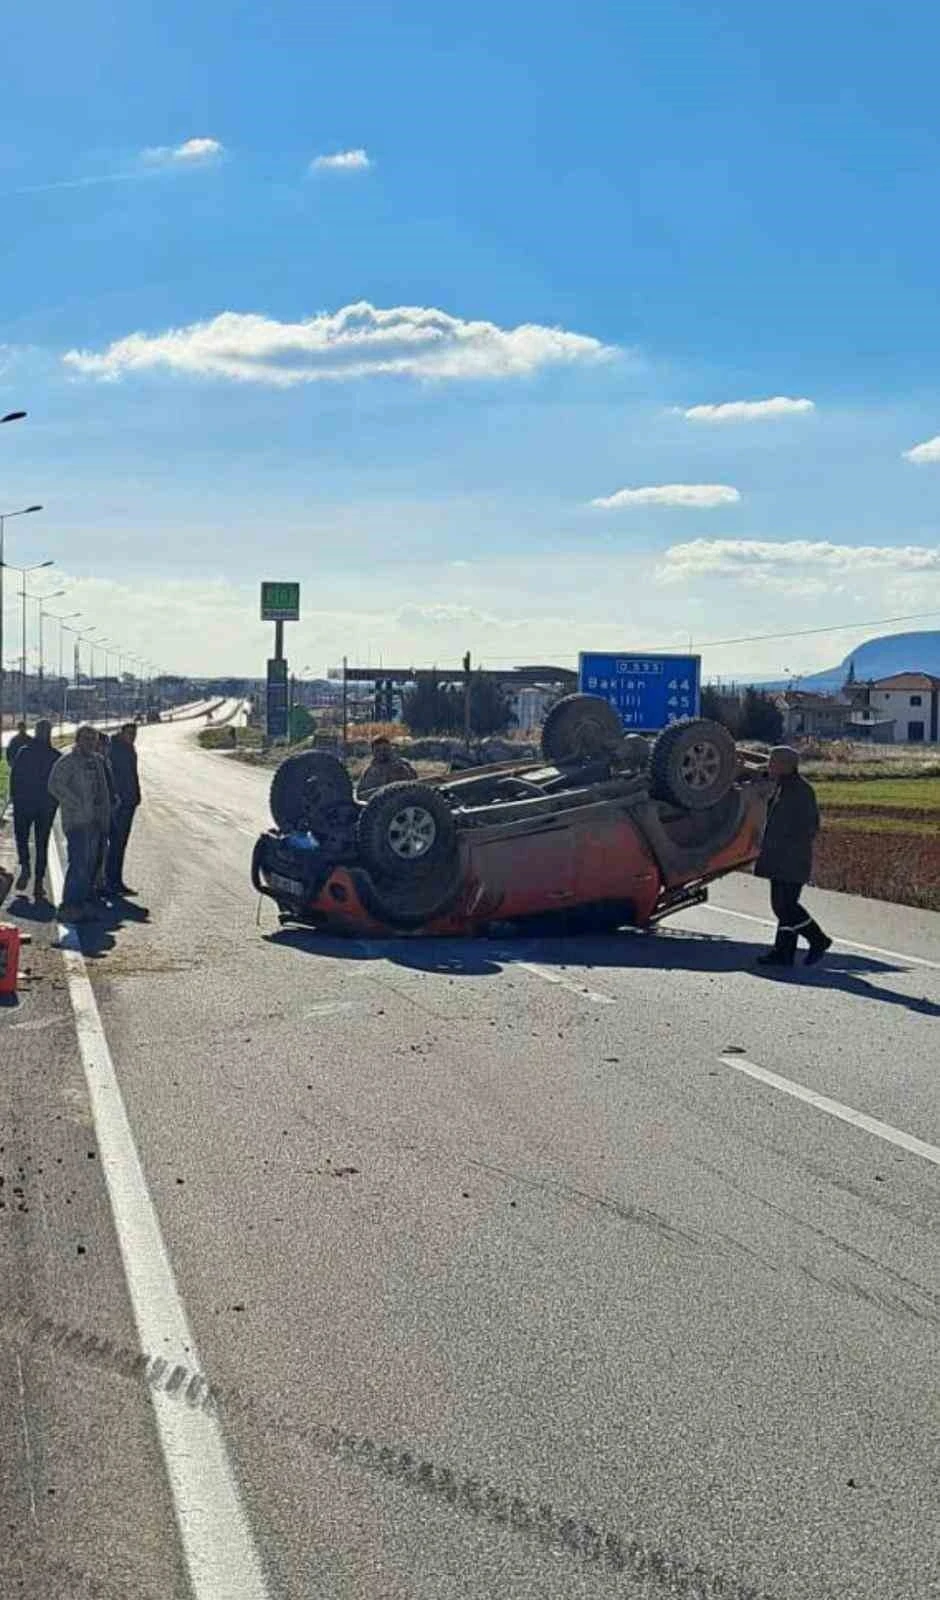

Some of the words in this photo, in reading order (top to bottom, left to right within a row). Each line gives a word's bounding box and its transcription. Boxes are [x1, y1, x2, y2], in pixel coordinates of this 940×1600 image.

[588, 676, 646, 689] Baklan
[667, 679, 690, 691] 44
[667, 695, 690, 708] 45
